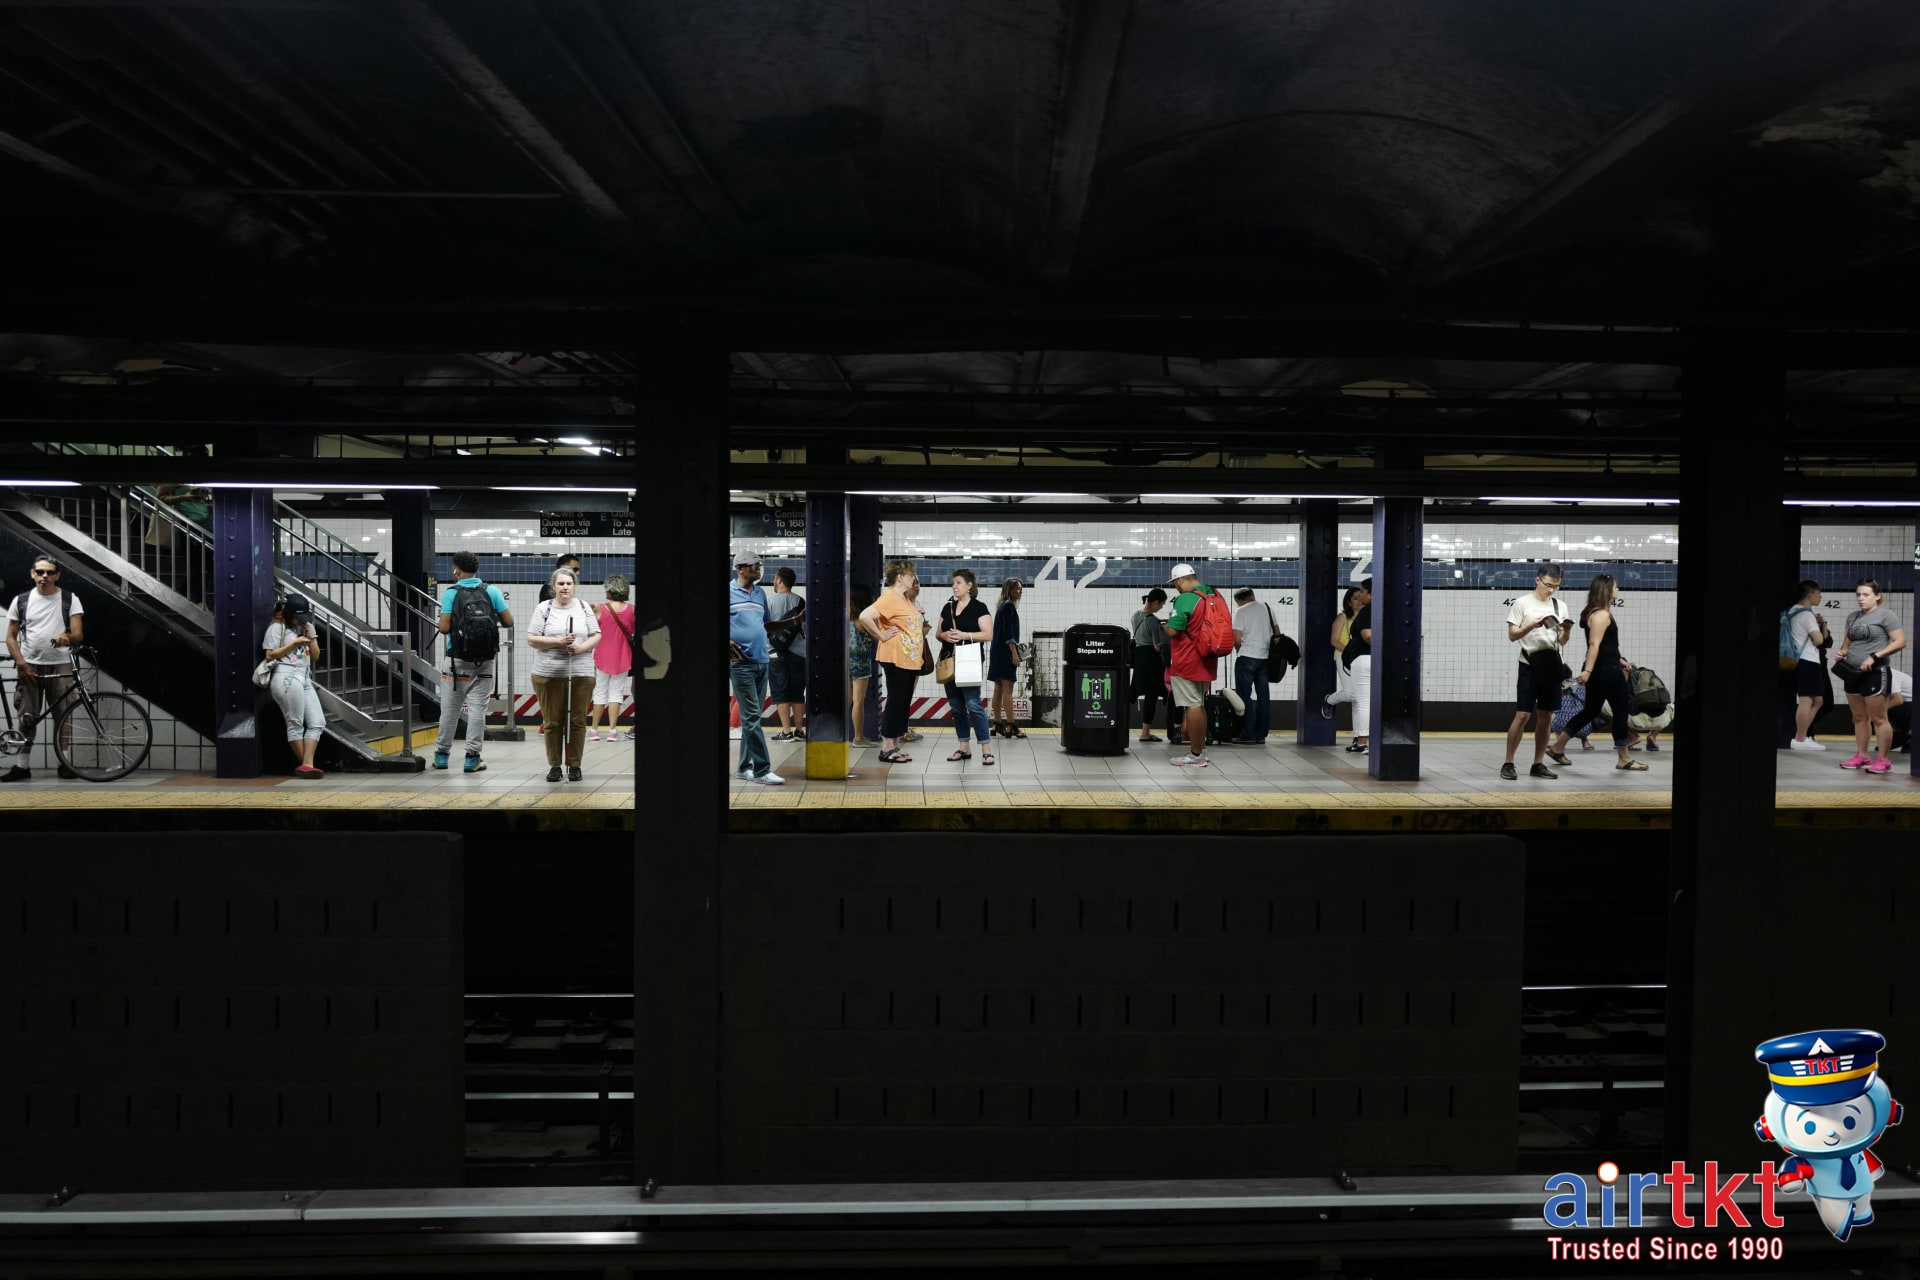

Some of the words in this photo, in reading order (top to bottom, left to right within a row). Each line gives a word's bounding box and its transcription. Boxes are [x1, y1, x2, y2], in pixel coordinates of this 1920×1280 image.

[600, 513, 607, 521] E
[762, 514, 770, 522] C
[541, 519, 575, 527] Queens
[578, 519, 590, 527] via
[612, 519, 622, 527] To
[775, 520, 785, 528] To
[789, 519, 804, 527] 168
[551, 527, 561, 535] Av
[564, 527, 588, 535] Local
[612, 528, 632, 536] Late
[784, 529, 805, 537] local
[1034, 555, 1106, 589] 42
[1278, 597, 1294, 605] 42
[1611, 599, 1625, 607] 42
[1824, 600, 1840, 608] 42
